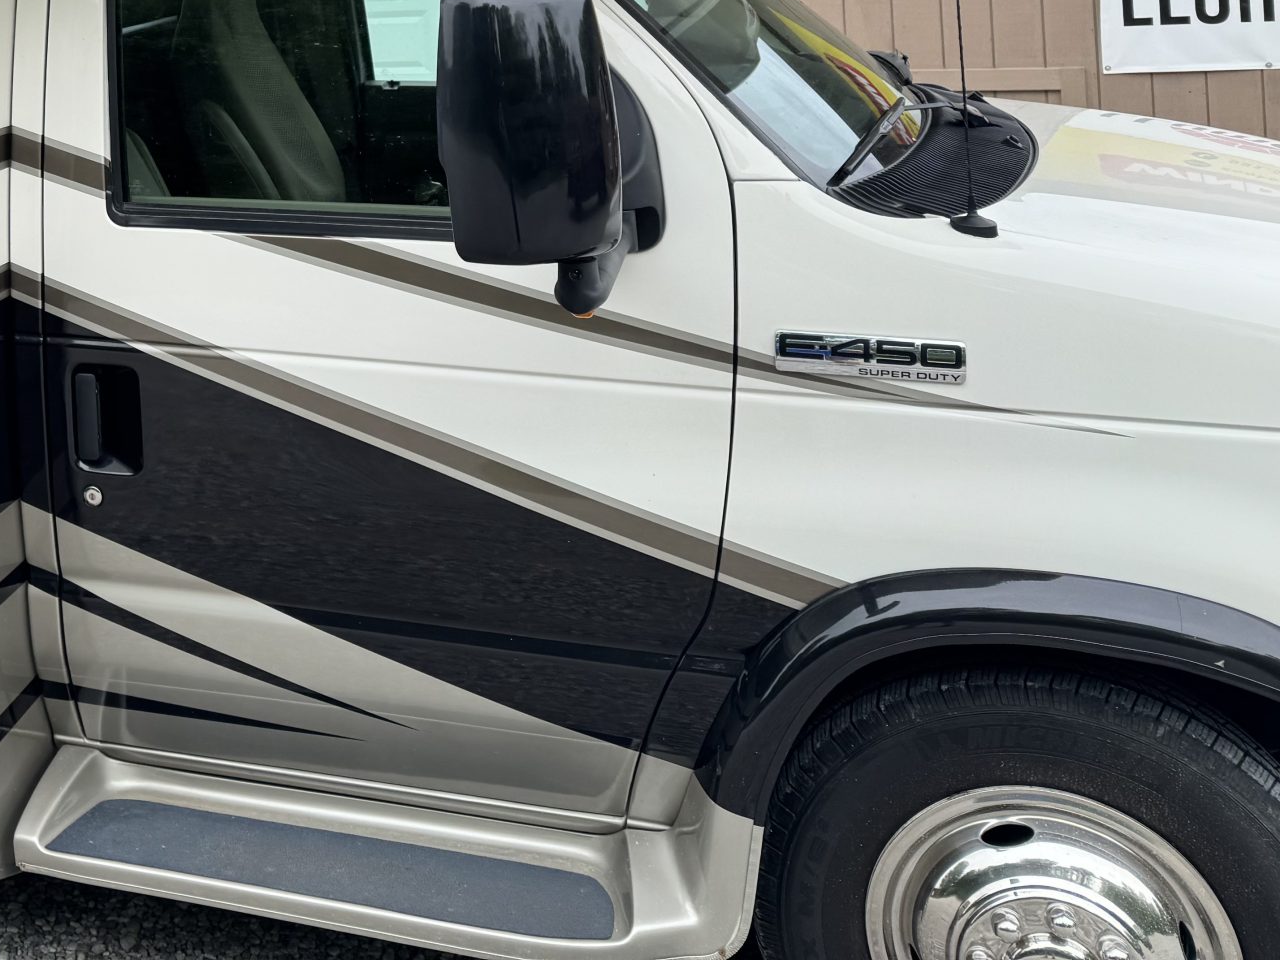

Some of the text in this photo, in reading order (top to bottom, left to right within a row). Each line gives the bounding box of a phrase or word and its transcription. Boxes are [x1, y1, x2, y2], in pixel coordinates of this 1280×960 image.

[779, 333, 963, 370] E-450
[858, 368, 961, 382] SUPER DUTY
